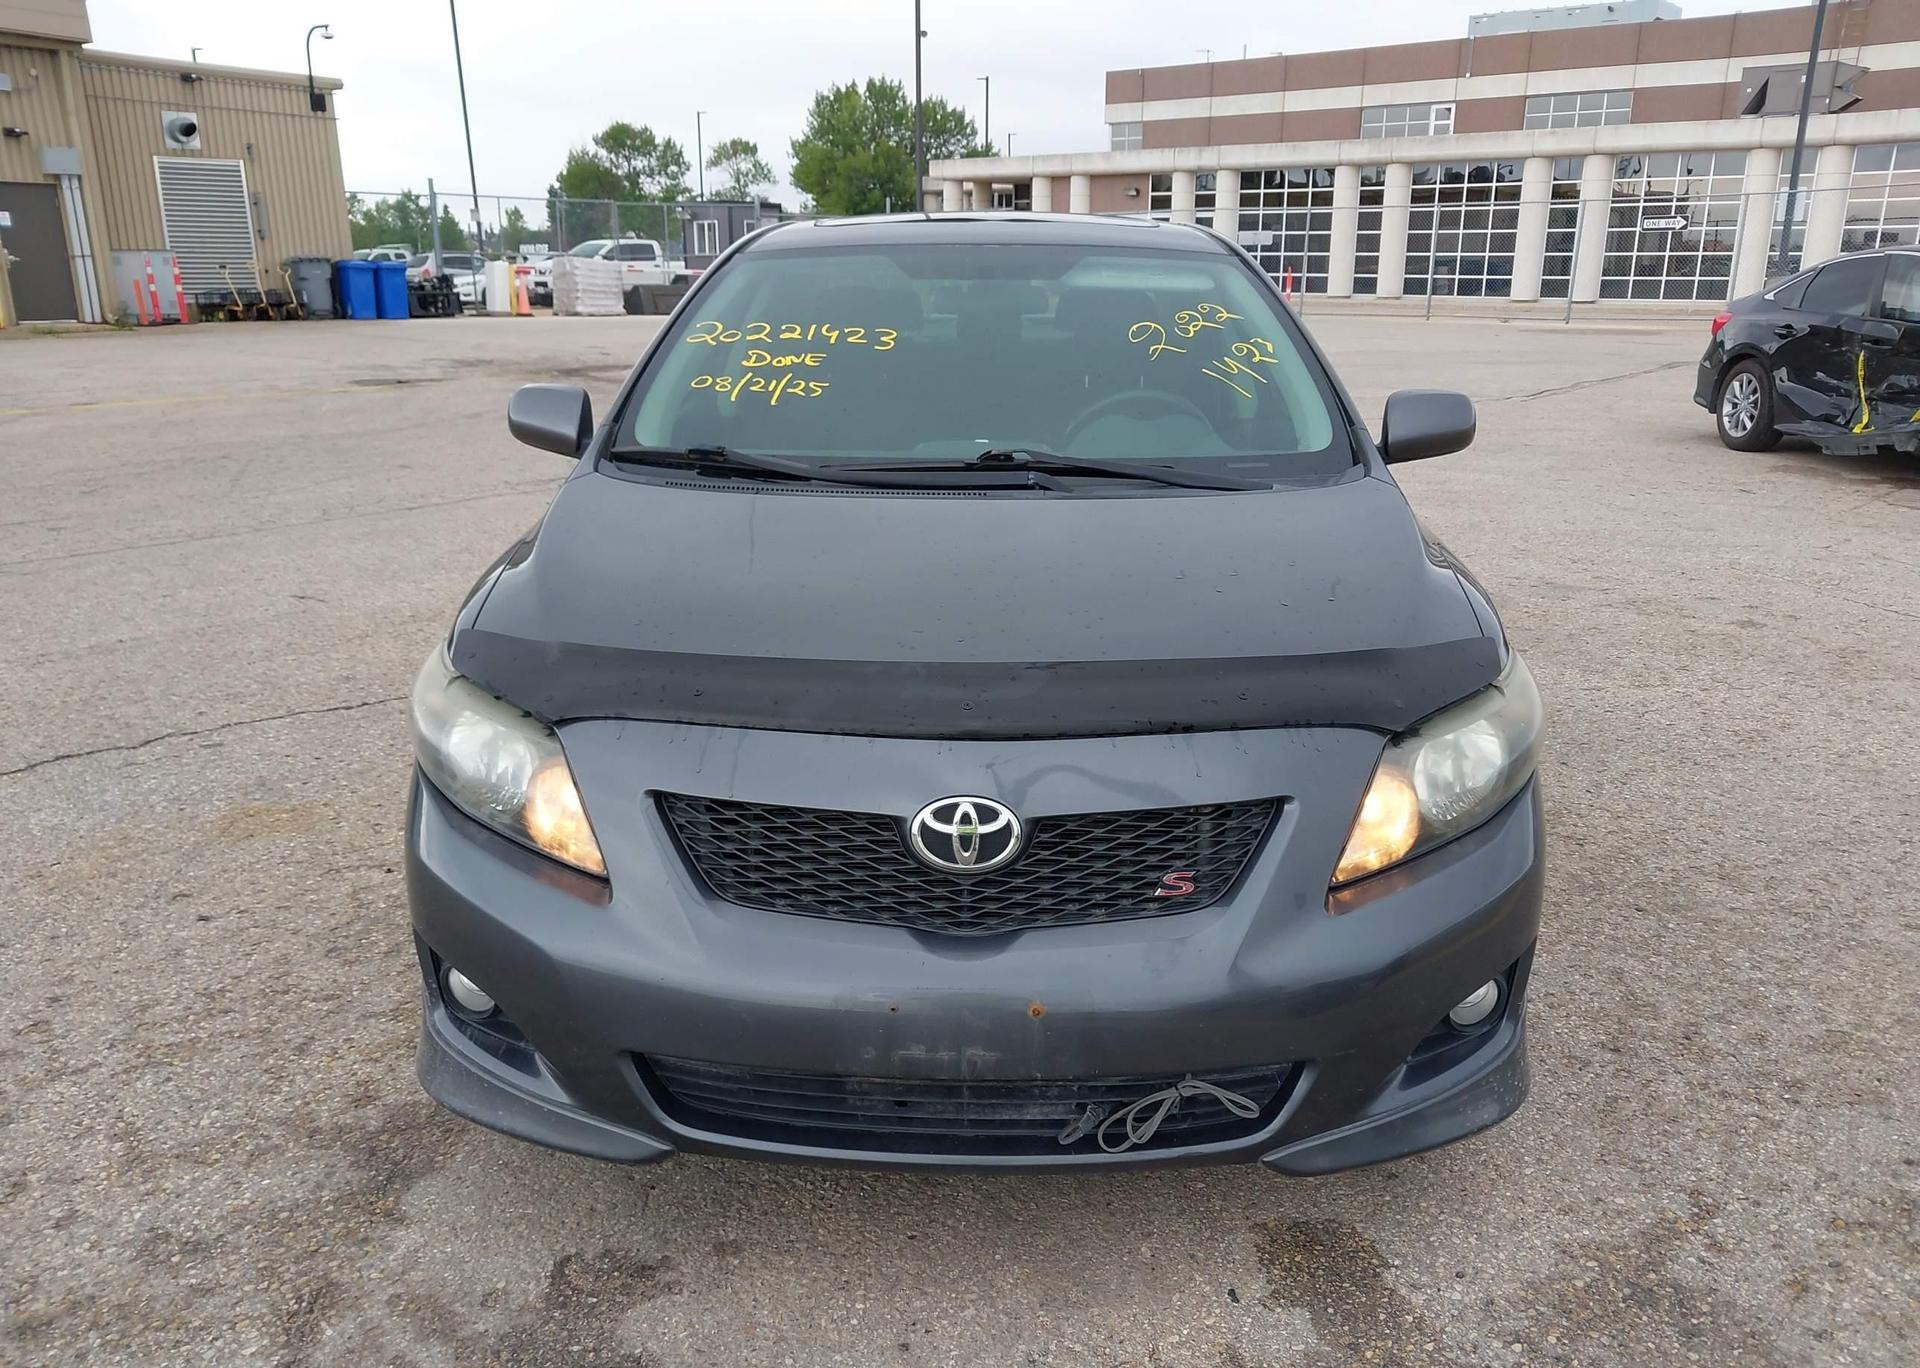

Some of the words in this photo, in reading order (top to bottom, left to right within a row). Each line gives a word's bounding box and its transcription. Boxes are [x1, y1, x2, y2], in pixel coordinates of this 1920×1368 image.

[686, 321, 898, 350] 20221423
[690, 372, 830, 405] 08/21/25
[1154, 871, 1197, 896] S
